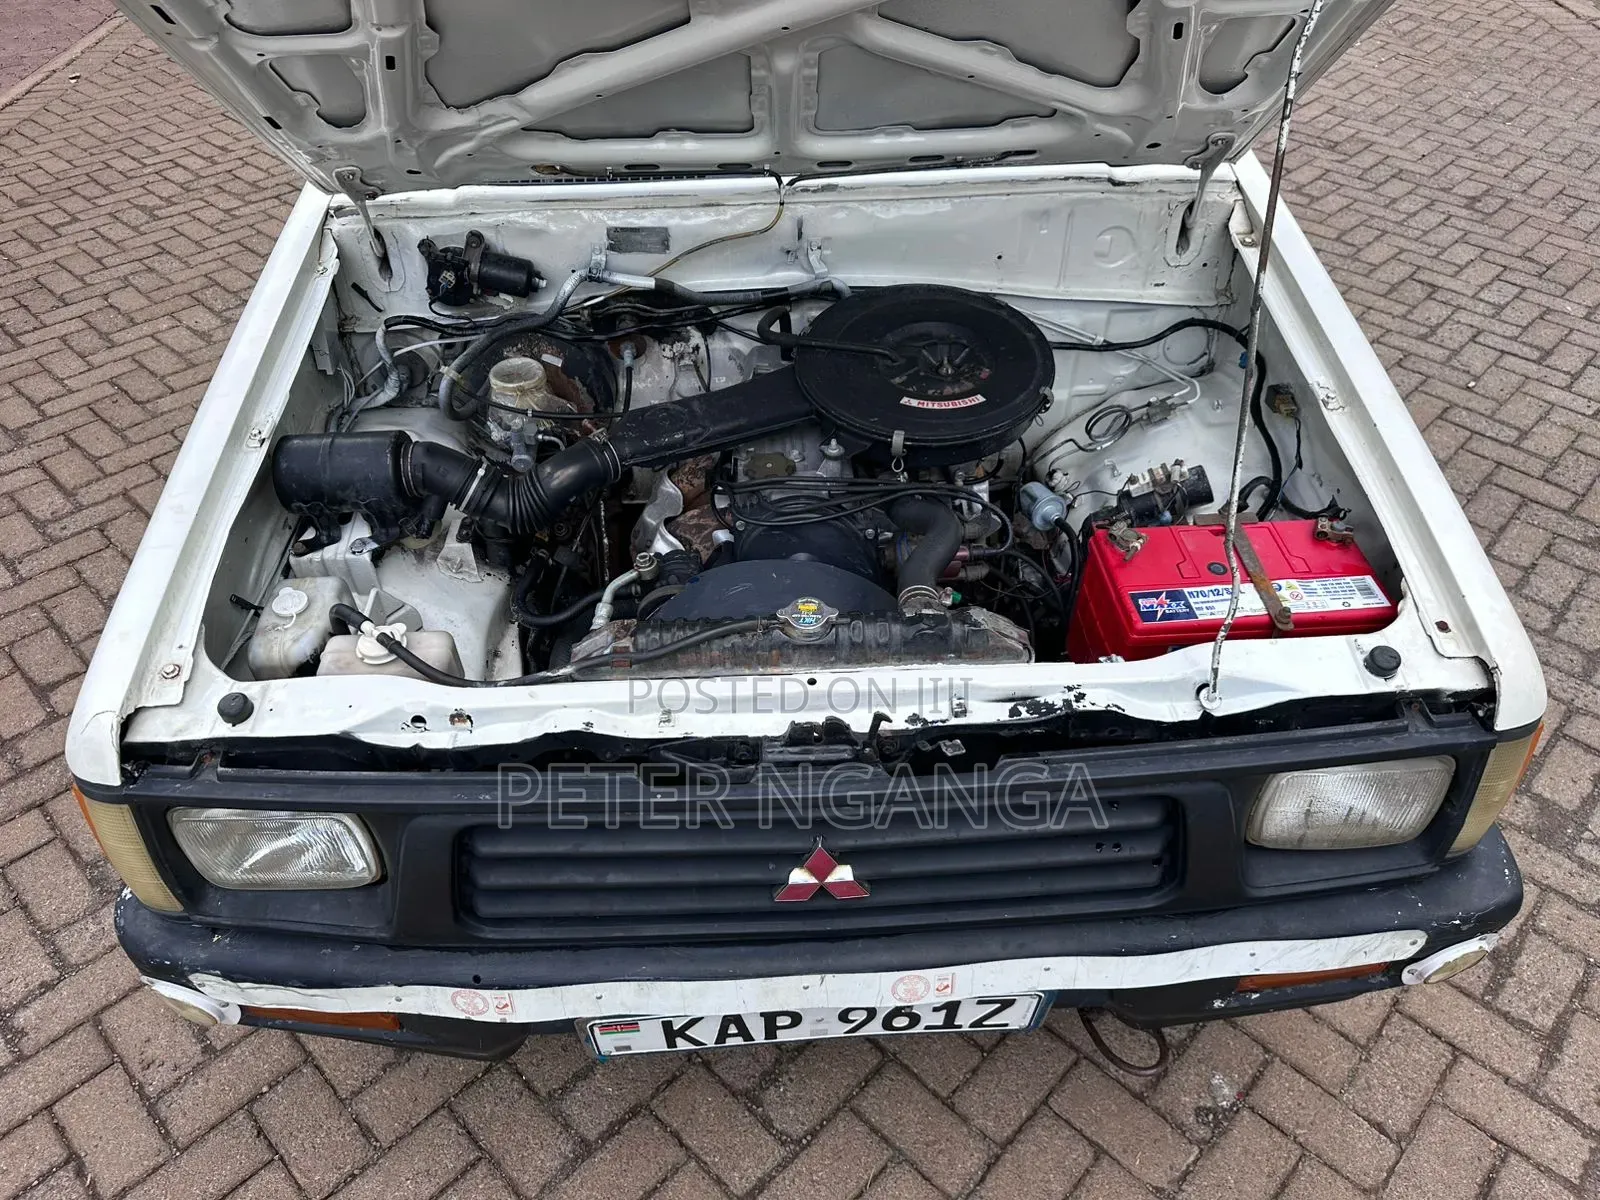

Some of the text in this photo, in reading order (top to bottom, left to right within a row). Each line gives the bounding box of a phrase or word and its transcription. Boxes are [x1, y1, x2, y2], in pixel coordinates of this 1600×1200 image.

[917, 396, 980, 408] MITSUBISHI
[661, 998, 1017, 1049] KAP 961Z
